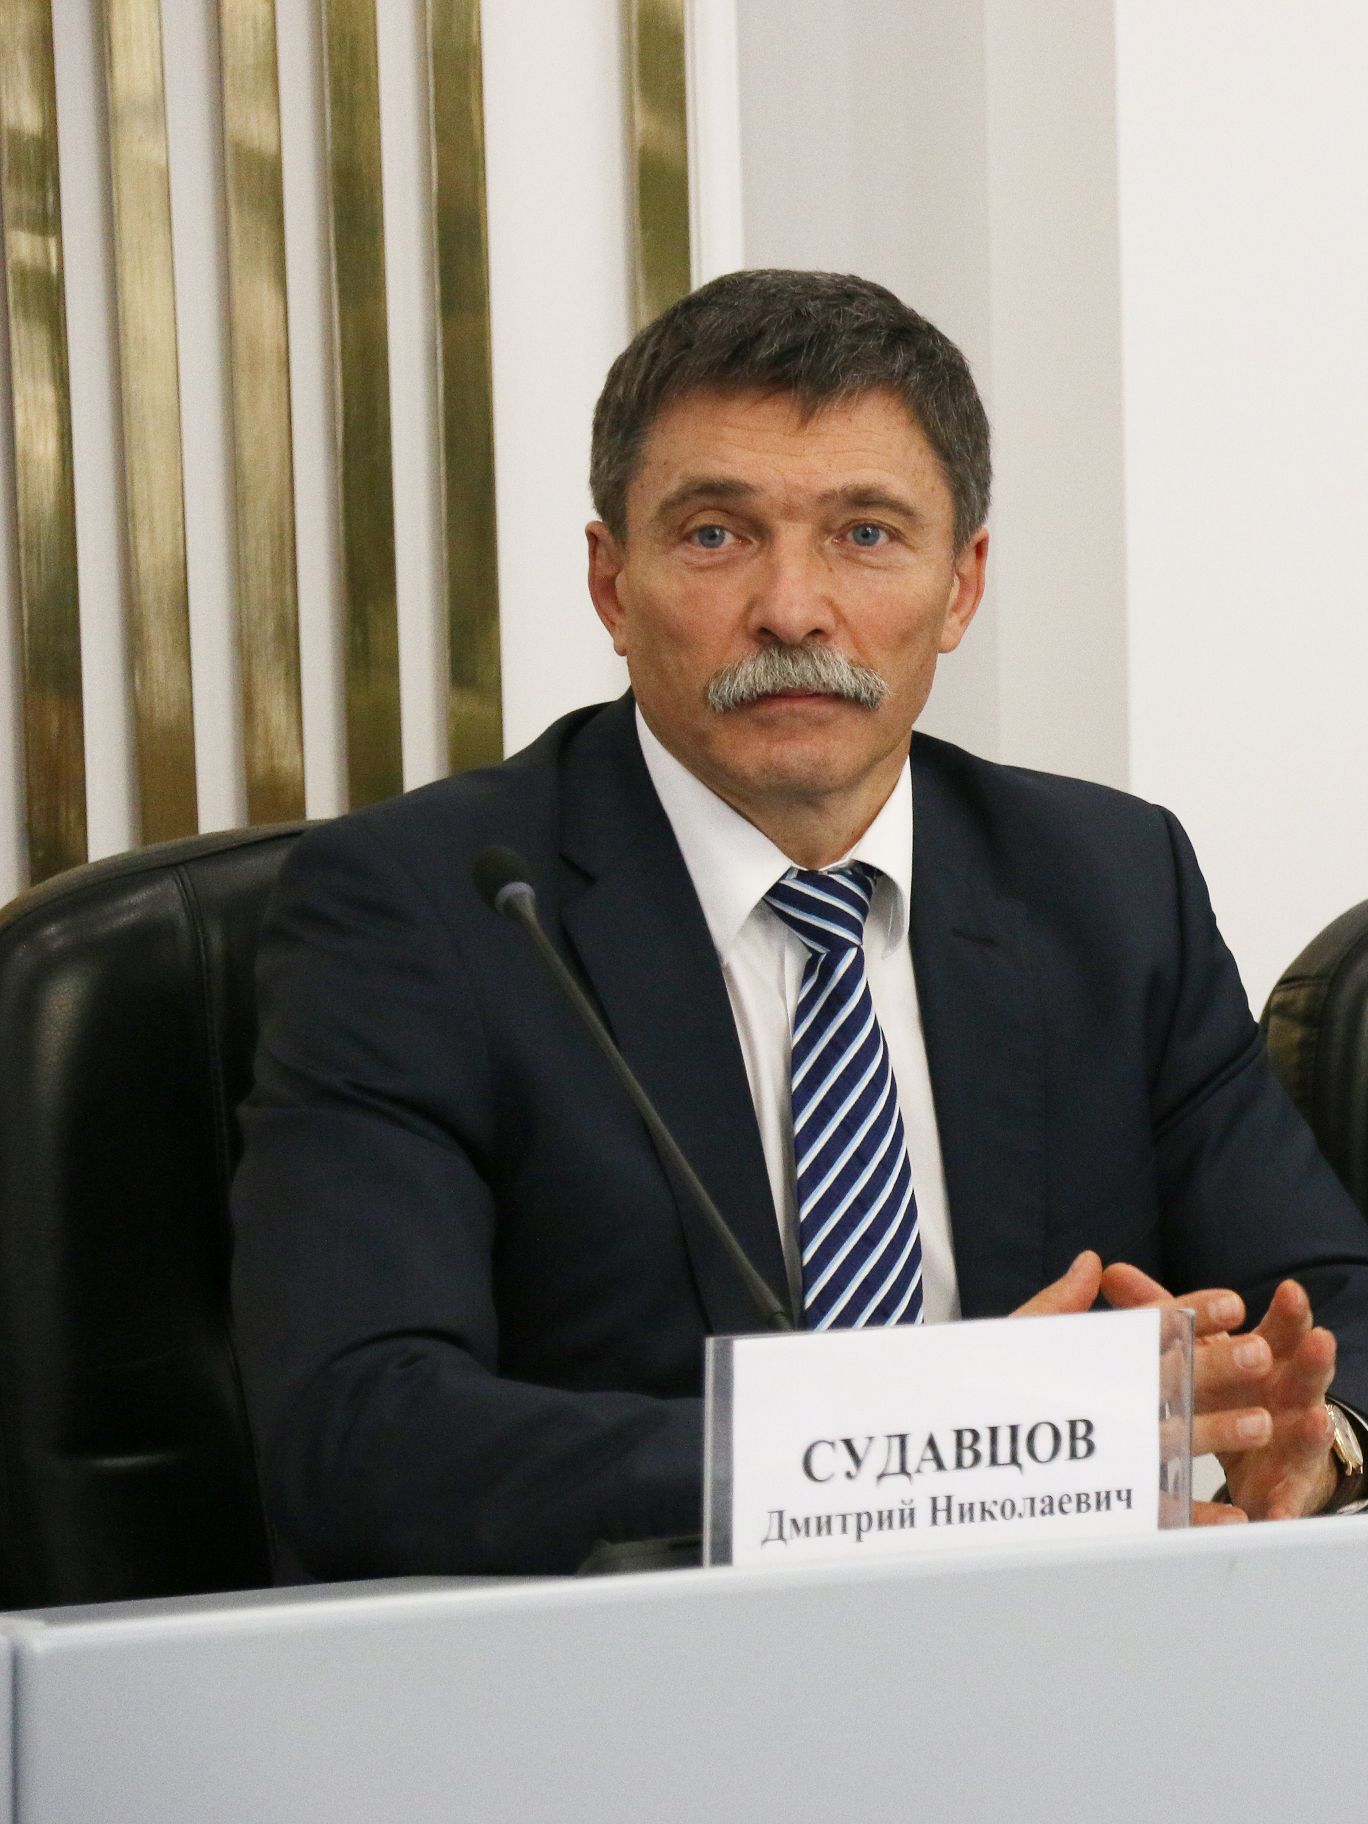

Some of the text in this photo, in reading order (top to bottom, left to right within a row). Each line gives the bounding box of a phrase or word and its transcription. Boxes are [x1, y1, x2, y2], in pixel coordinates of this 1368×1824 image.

[801, 1417, 1097, 1484] СУДАВЦОВ
[761, 1487, 1134, 1545] Дмитрий Николаевич
